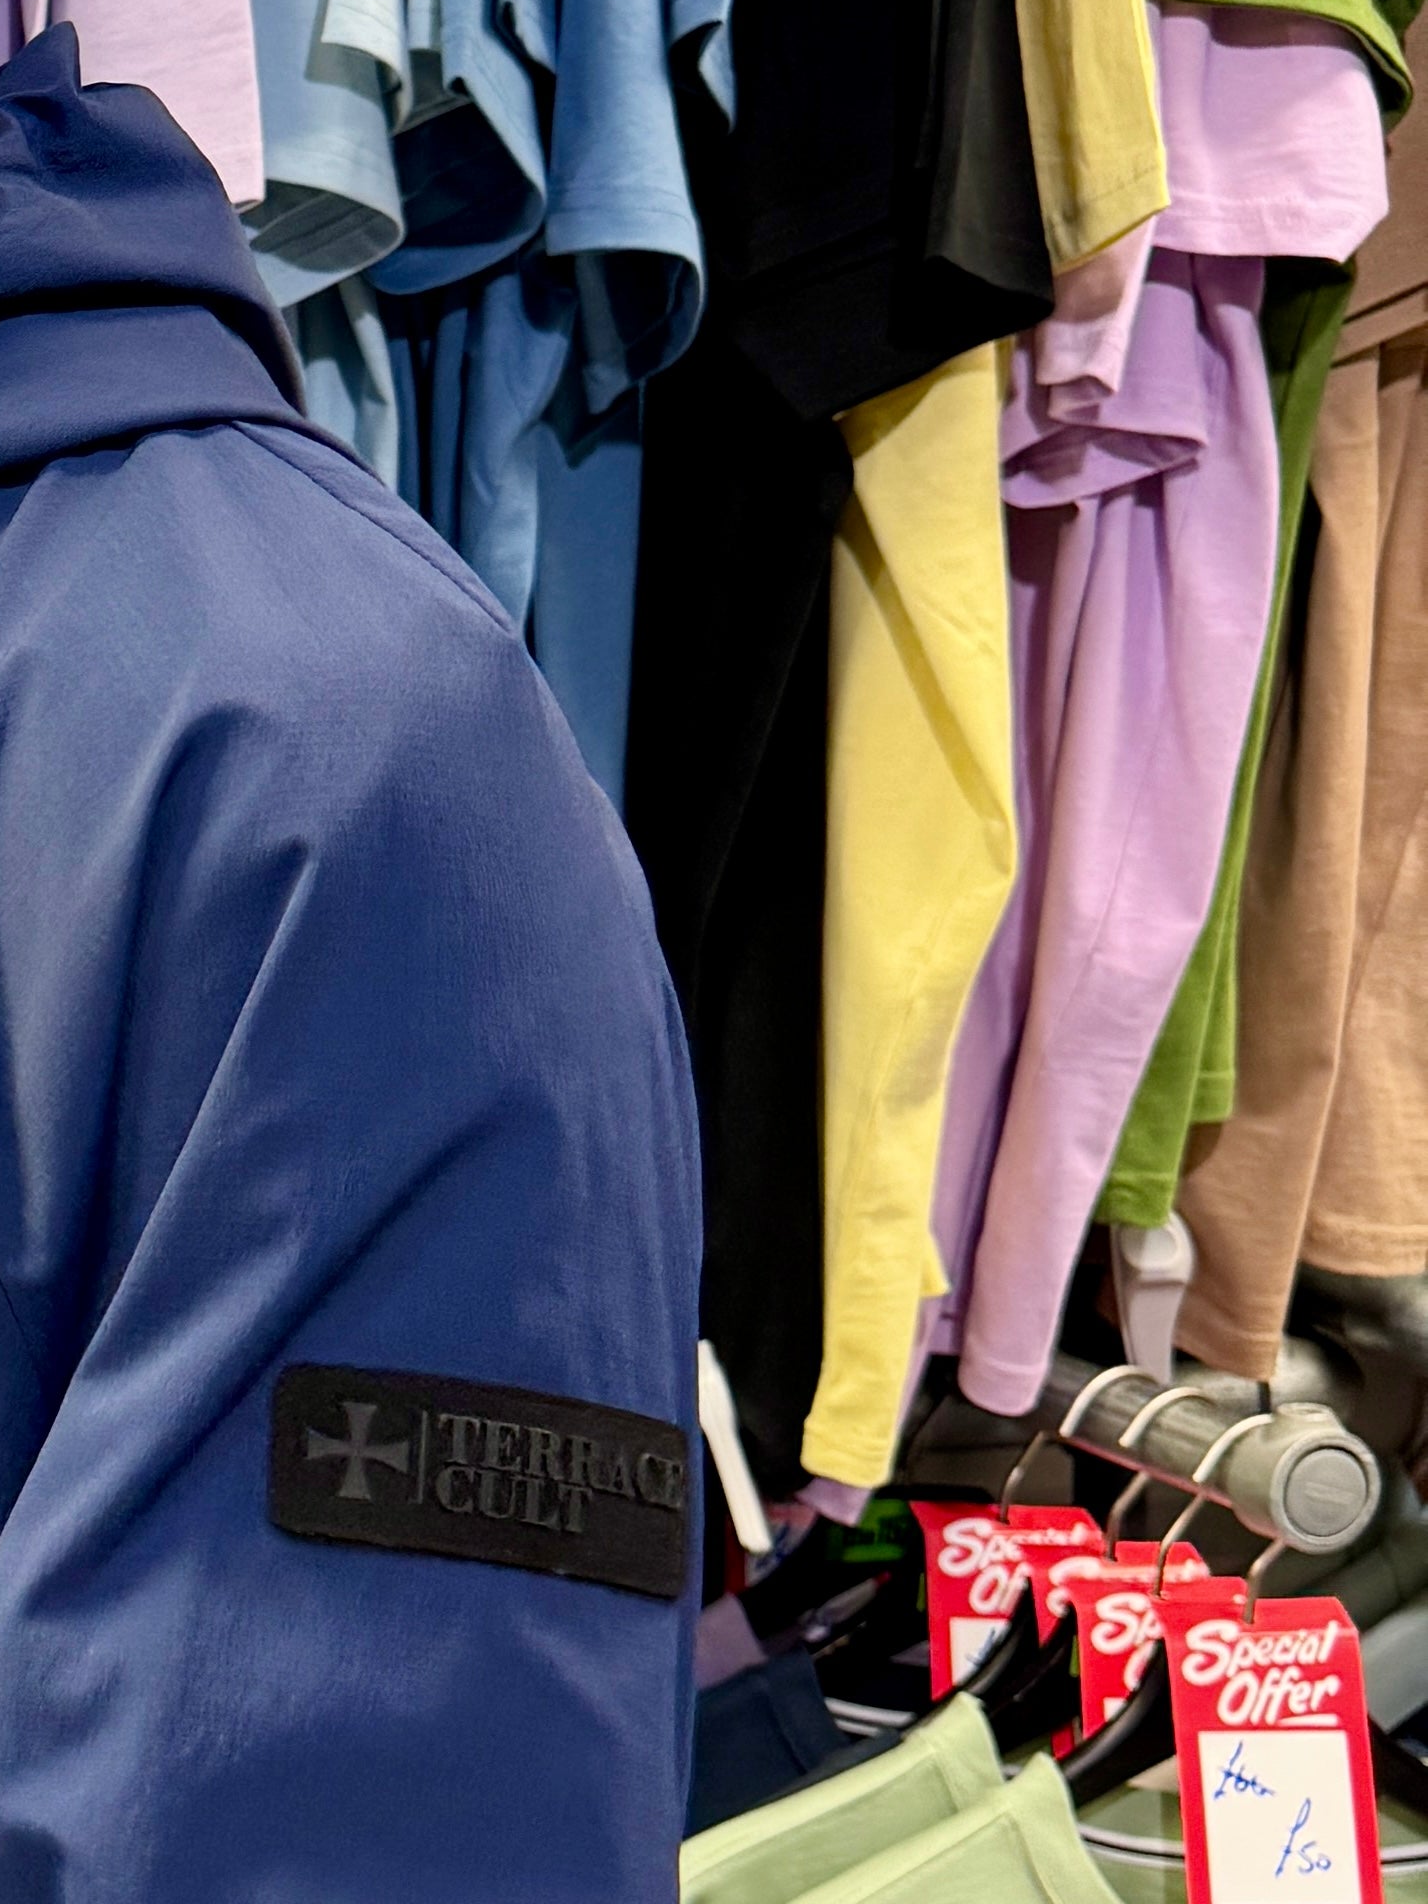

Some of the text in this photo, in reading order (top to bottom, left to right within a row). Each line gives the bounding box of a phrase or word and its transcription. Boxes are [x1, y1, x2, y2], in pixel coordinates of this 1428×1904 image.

[436, 1466, 593, 1533] CULT
[1182, 1619, 1339, 1685] Special
[1217, 1665, 1341, 1726] Offer
